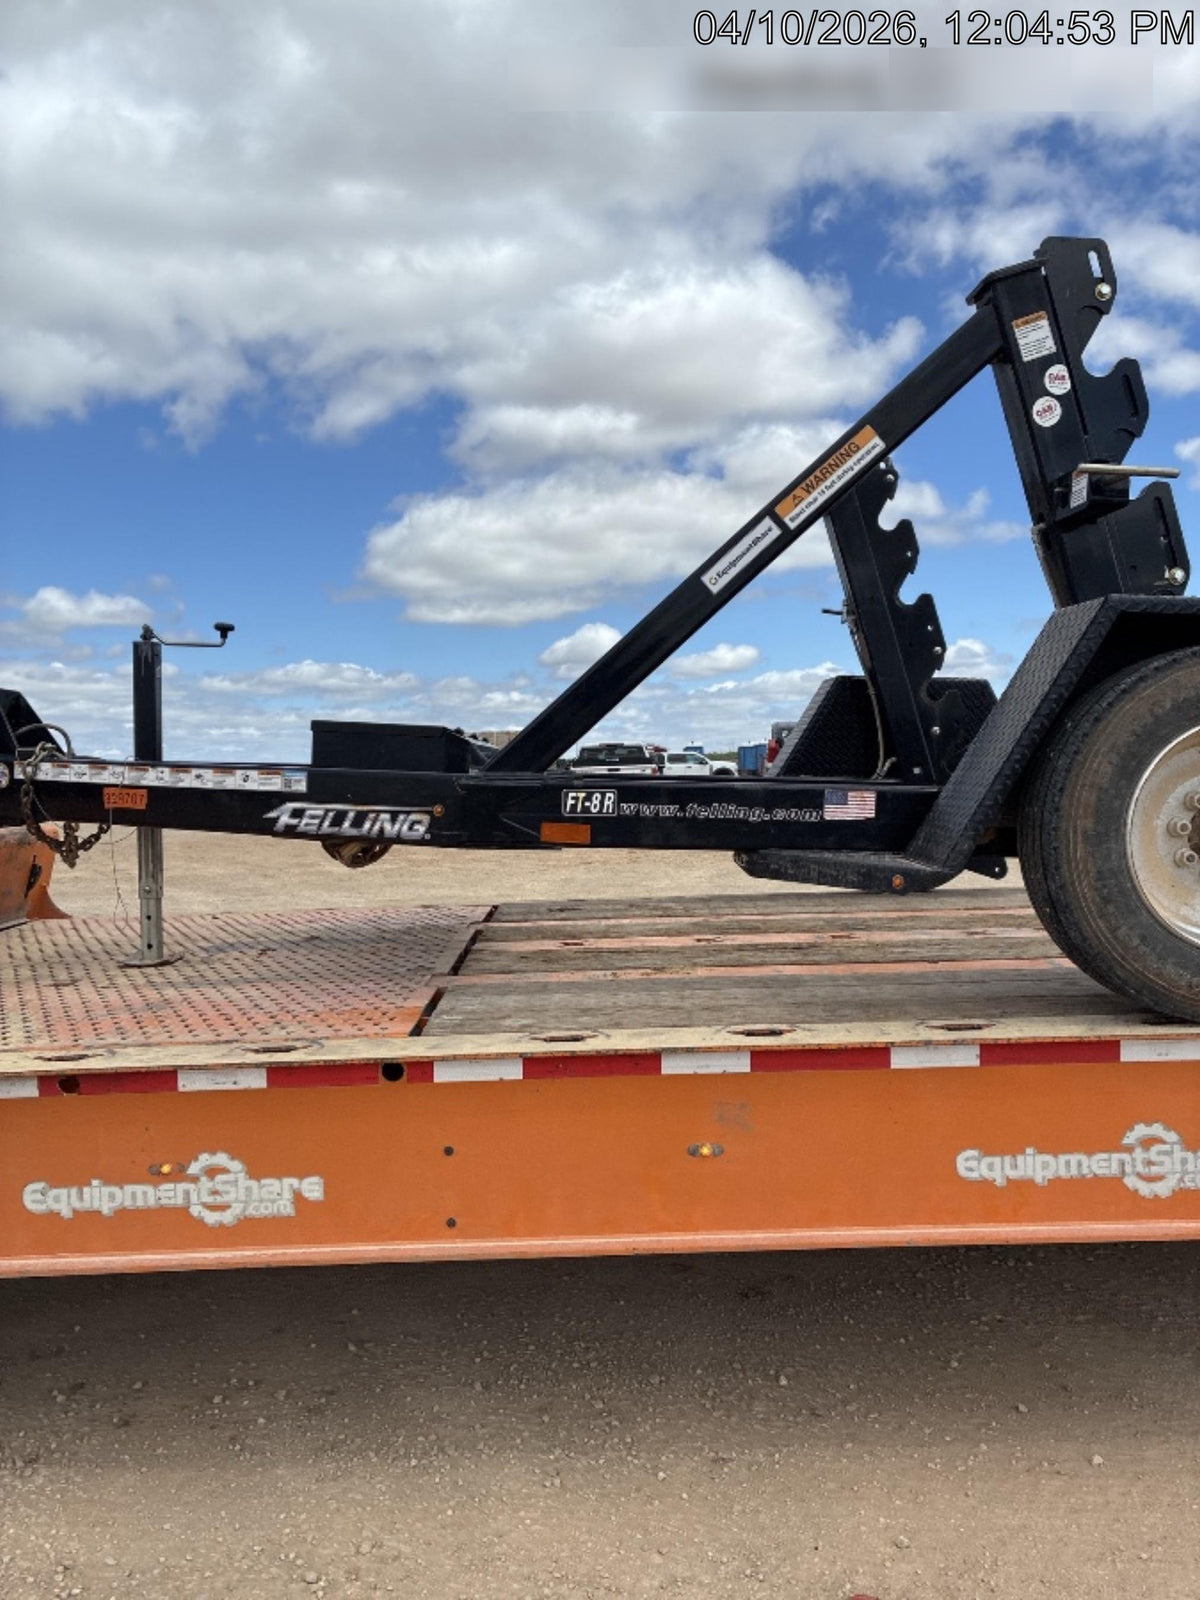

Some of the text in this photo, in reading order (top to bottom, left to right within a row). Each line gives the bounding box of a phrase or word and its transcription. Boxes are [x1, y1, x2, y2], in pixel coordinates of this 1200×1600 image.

[801, 441, 860, 494] WARNING
[262, 802, 432, 840] FELLING
[619, 803, 822, 823] www.felling.com
[955, 1143, 1200, 1187] EquipmentSh
[22, 1174, 325, 1219] EquipmentShare
